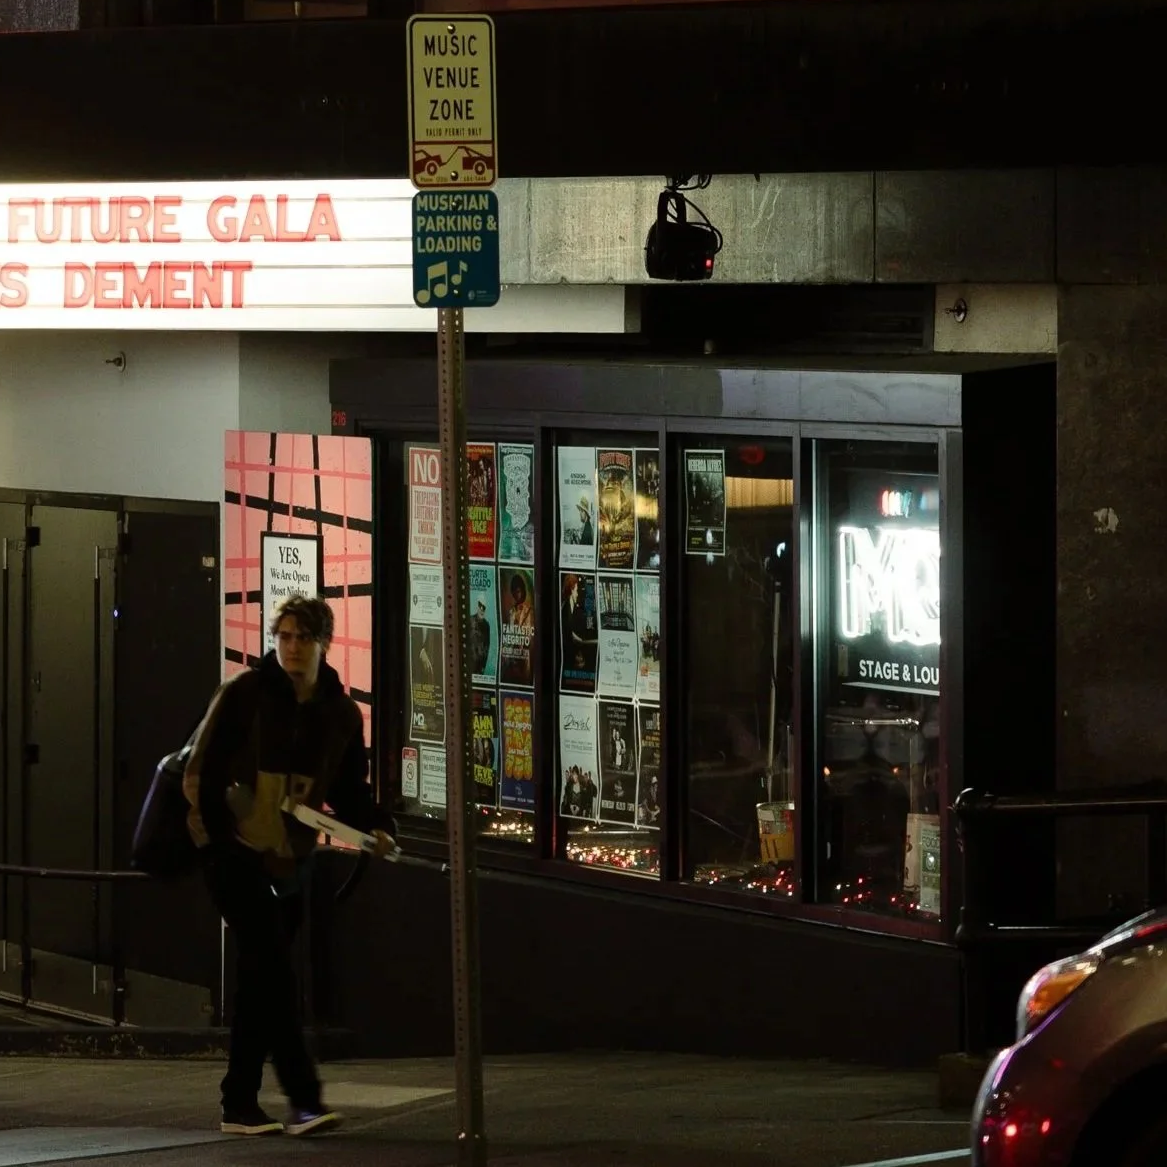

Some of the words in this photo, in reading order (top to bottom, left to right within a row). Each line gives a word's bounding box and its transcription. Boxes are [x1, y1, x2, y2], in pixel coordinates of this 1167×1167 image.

[424, 35, 478, 56] MUSIC
[423, 67, 480, 88] VENUE
[429, 99, 475, 121] ZONE
[416, 194, 489, 211] MUSICIAN
[7, 195, 184, 244] FUTURE
[206, 193, 342, 242] GALA
[416, 215, 482, 232] PARKING
[486, 214, 497, 231] &
[417, 236, 482, 253] LOADING
[63, 260, 253, 309] DEMENT
[414, 453, 439, 484] NO
[278, 546, 302, 568] YES,
[271, 568, 280, 580] We
[281, 569, 292, 580] Are
[293, 570, 310, 584] Open
[469, 578, 491, 588] LGADO
[271, 584, 286, 596] Most
[502, 623, 535, 636] FANTASTIC
[502, 634, 530, 646] NEGRITO
[859, 659, 899, 681] STAGE
[902, 664, 911, 682] &
[473, 715, 493, 730] AWN
